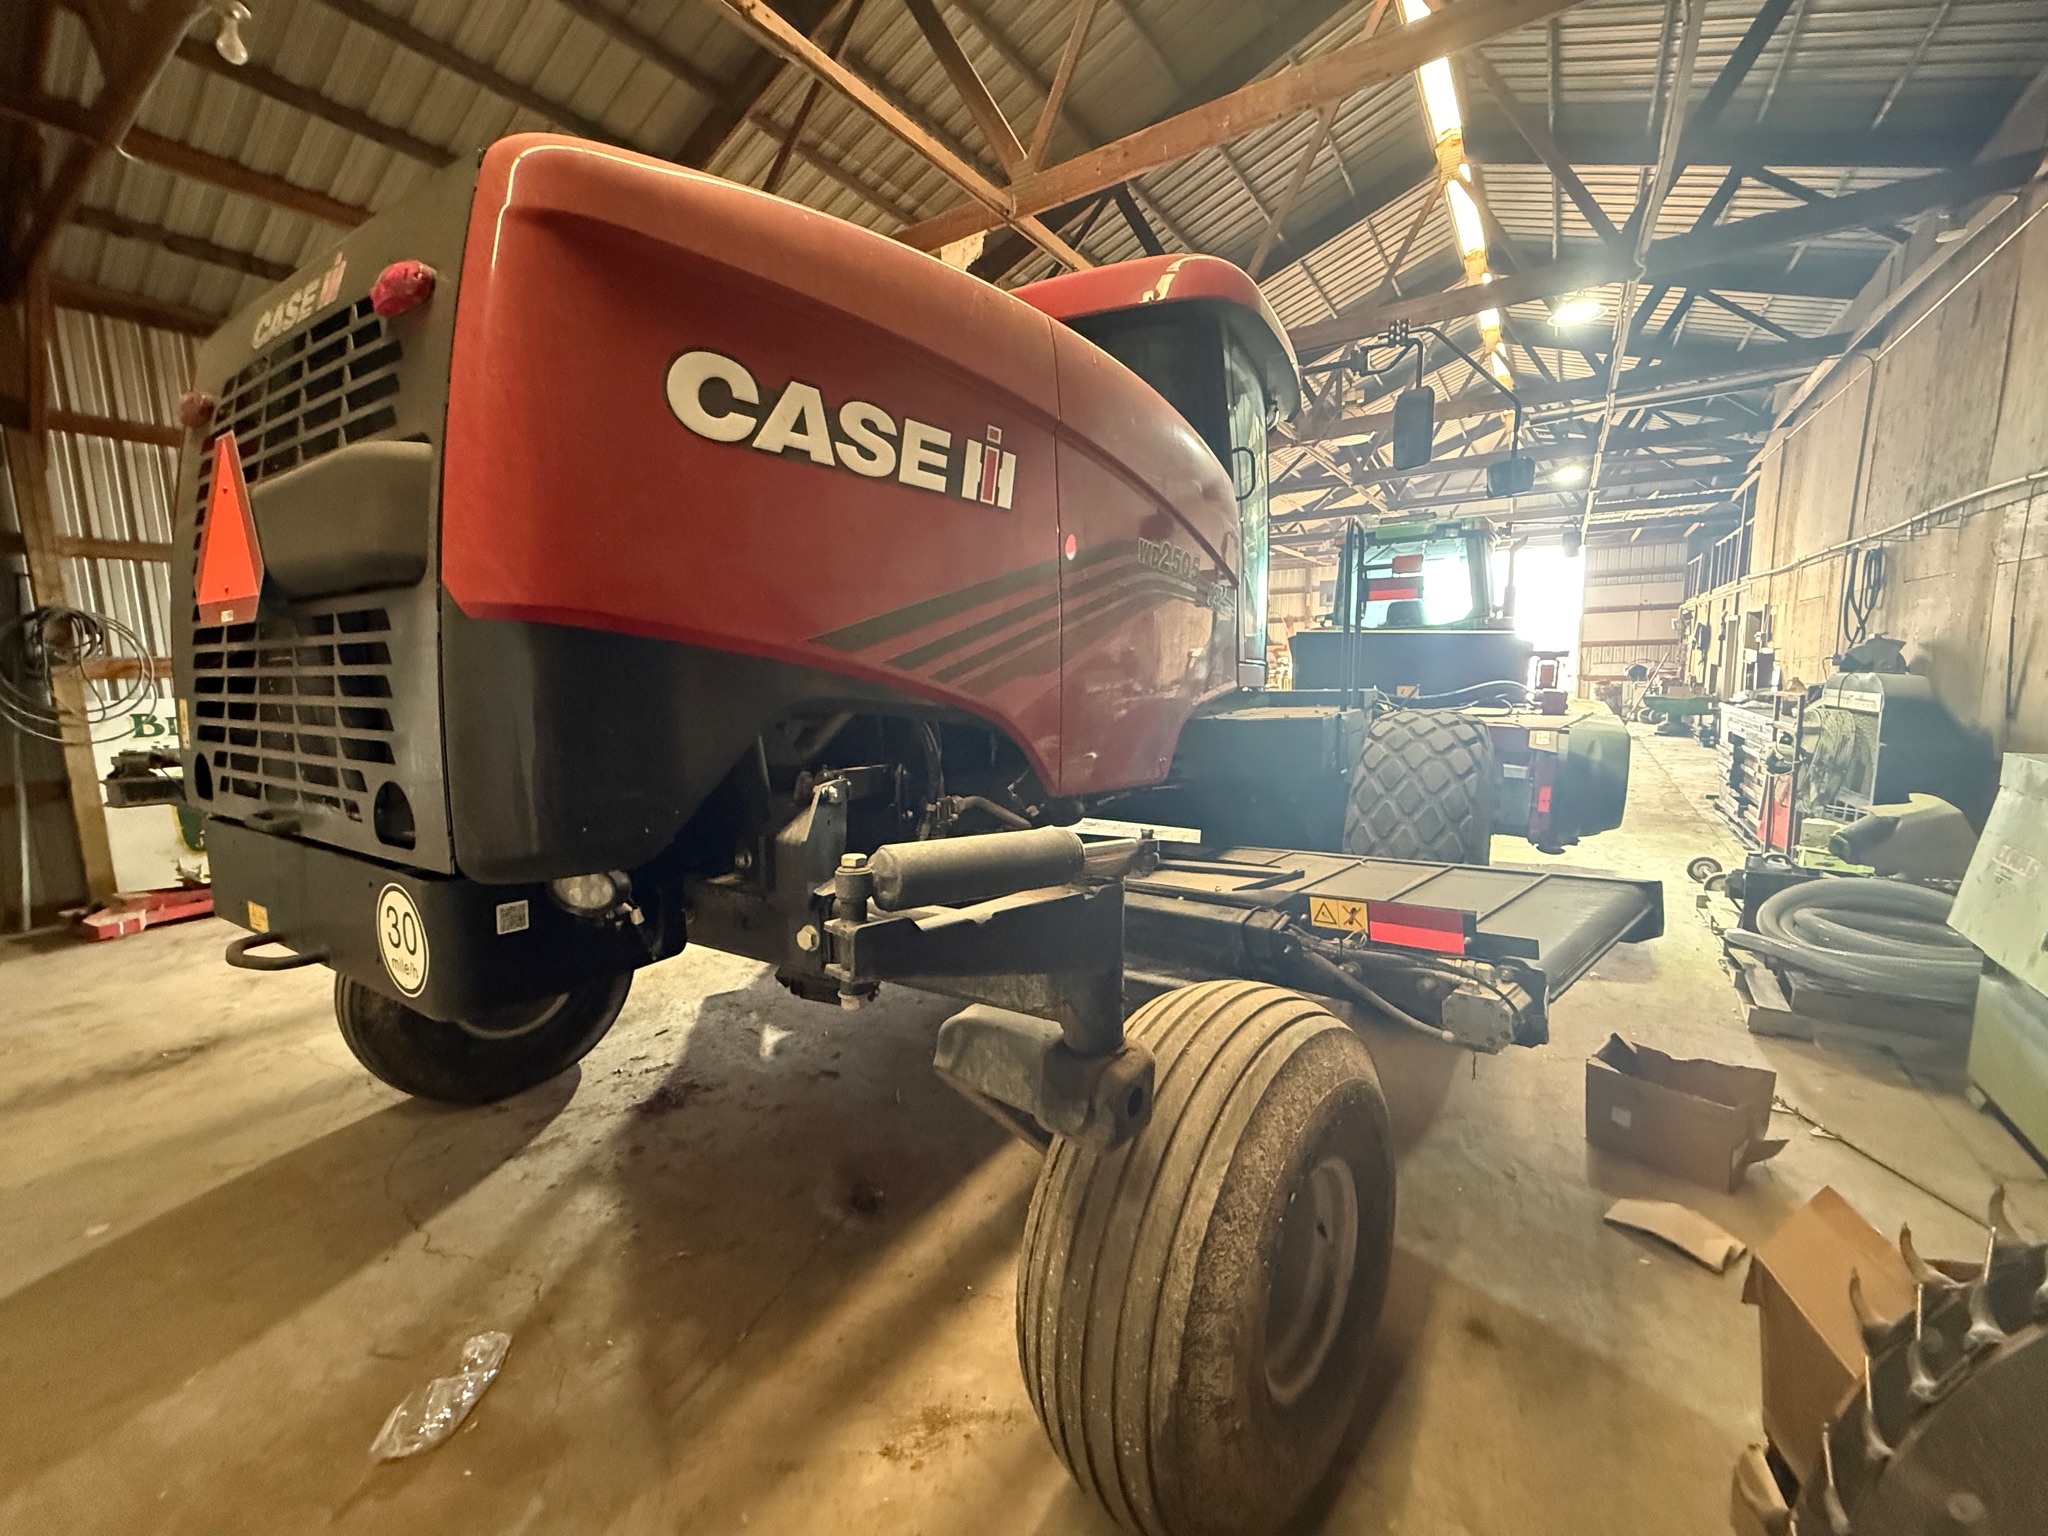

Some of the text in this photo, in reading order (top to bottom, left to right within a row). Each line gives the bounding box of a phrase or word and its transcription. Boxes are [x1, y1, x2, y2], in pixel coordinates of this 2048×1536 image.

[252, 278, 321, 349] CASE
[666, 350, 952, 493] CASE
[386, 905, 418, 956] 30
